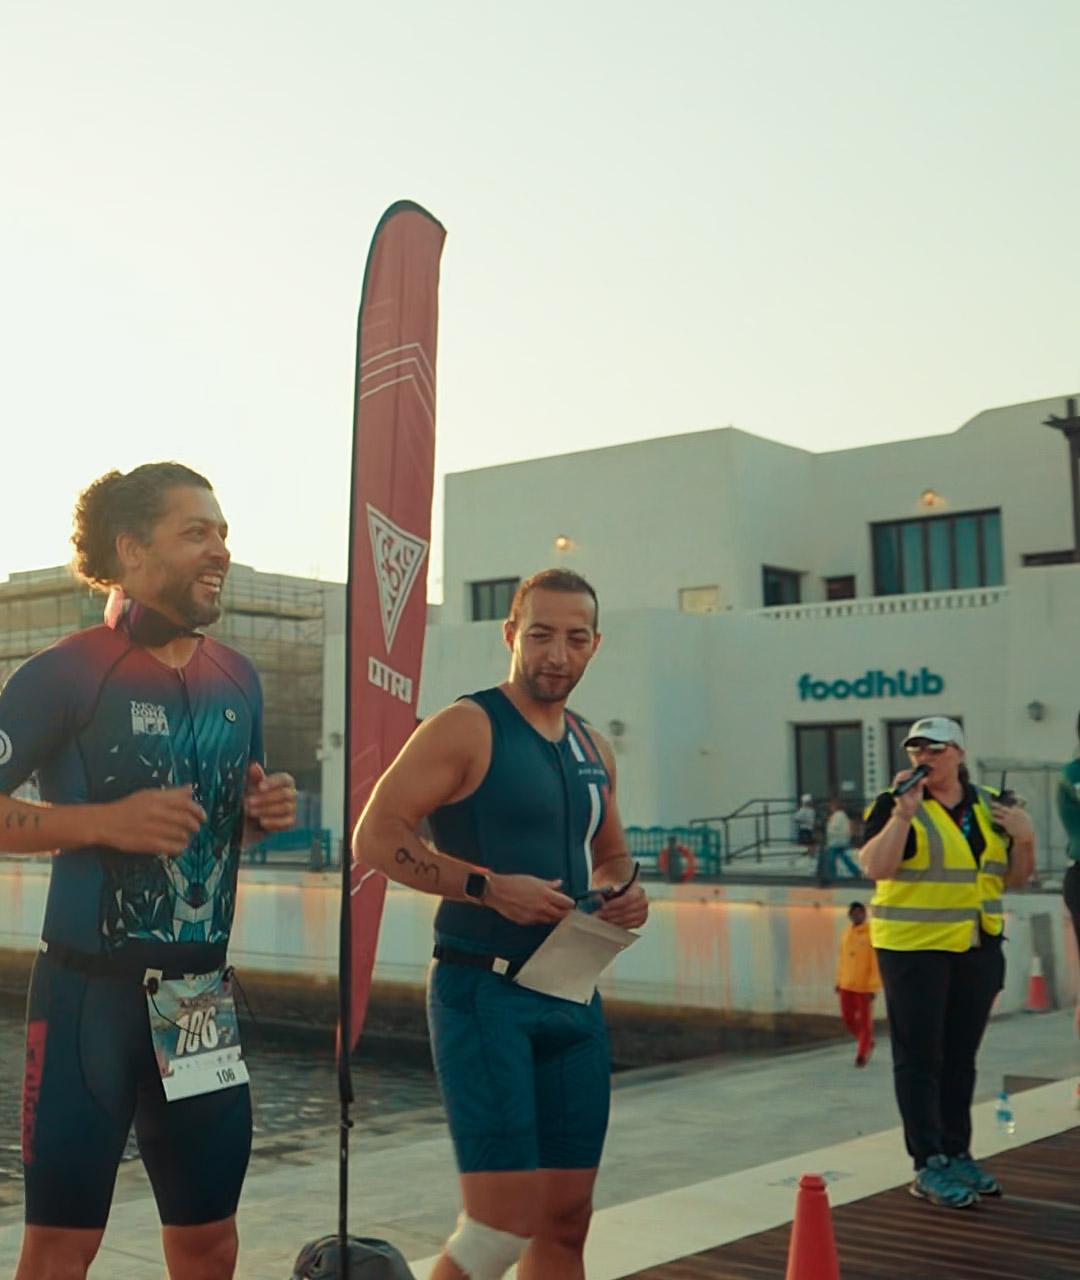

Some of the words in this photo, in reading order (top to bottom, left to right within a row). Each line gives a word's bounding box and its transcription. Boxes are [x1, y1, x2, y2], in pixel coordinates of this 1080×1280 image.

[798, 667, 944, 701] foodhub
[175, 1005, 219, 1056] 106
[216, 1067, 236, 1085] 106
